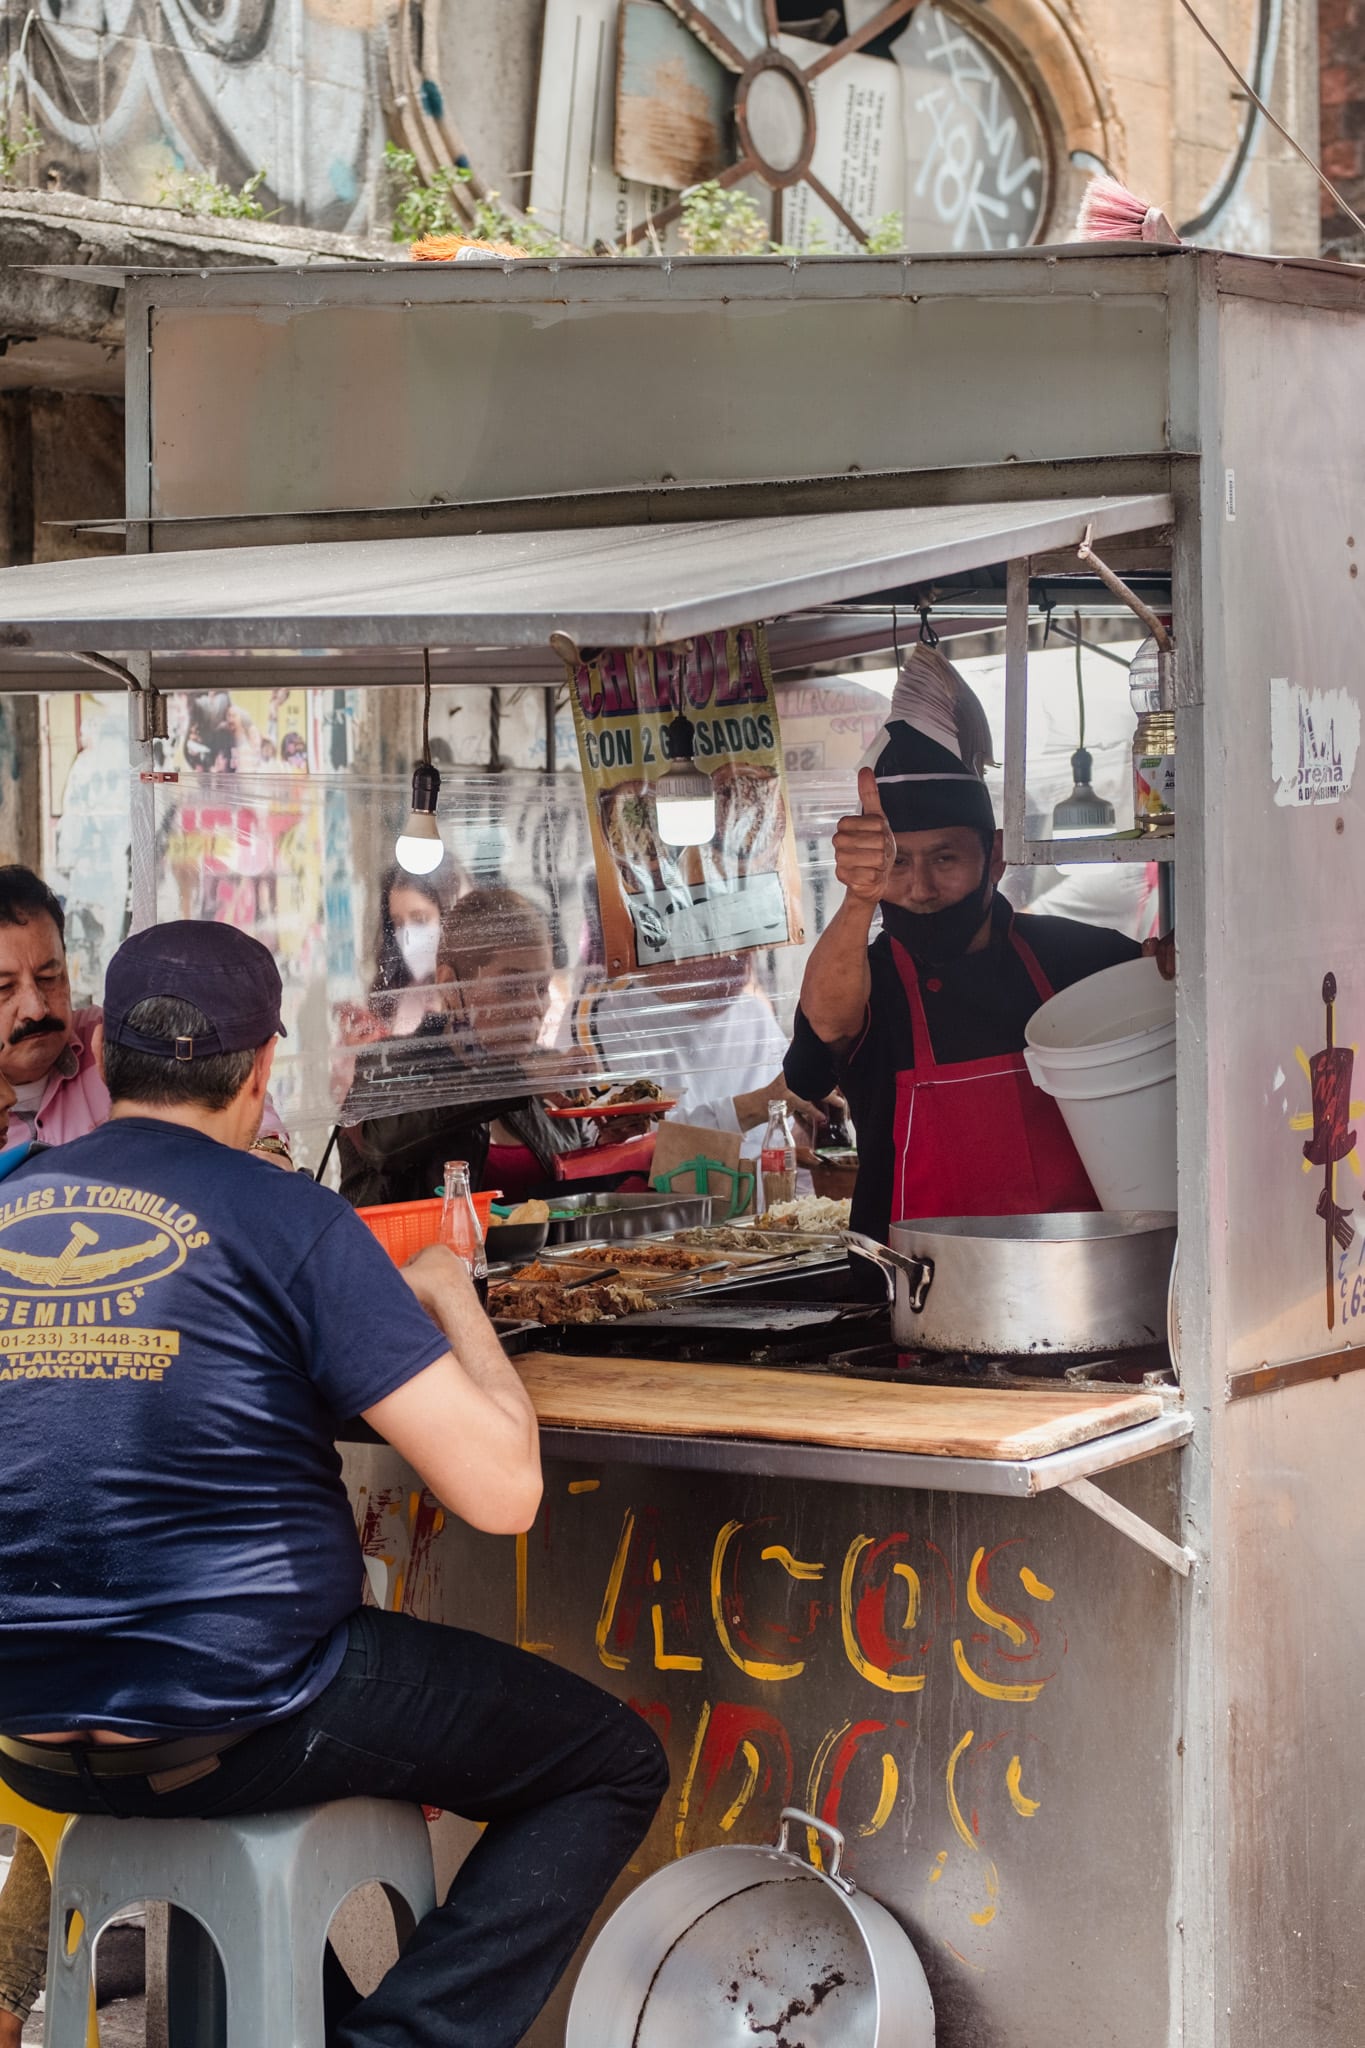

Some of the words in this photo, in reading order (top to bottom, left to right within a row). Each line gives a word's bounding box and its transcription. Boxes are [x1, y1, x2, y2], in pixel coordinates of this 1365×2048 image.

[585, 729, 633, 769] CON
[641, 727, 656, 763] 2
[660, 714, 775, 761] GSADOS
[63, 1185, 80, 1207] Y
[86, 1185, 210, 1249] TORNILLOS
[6, 1351, 172, 1368] TLALCONTENO
